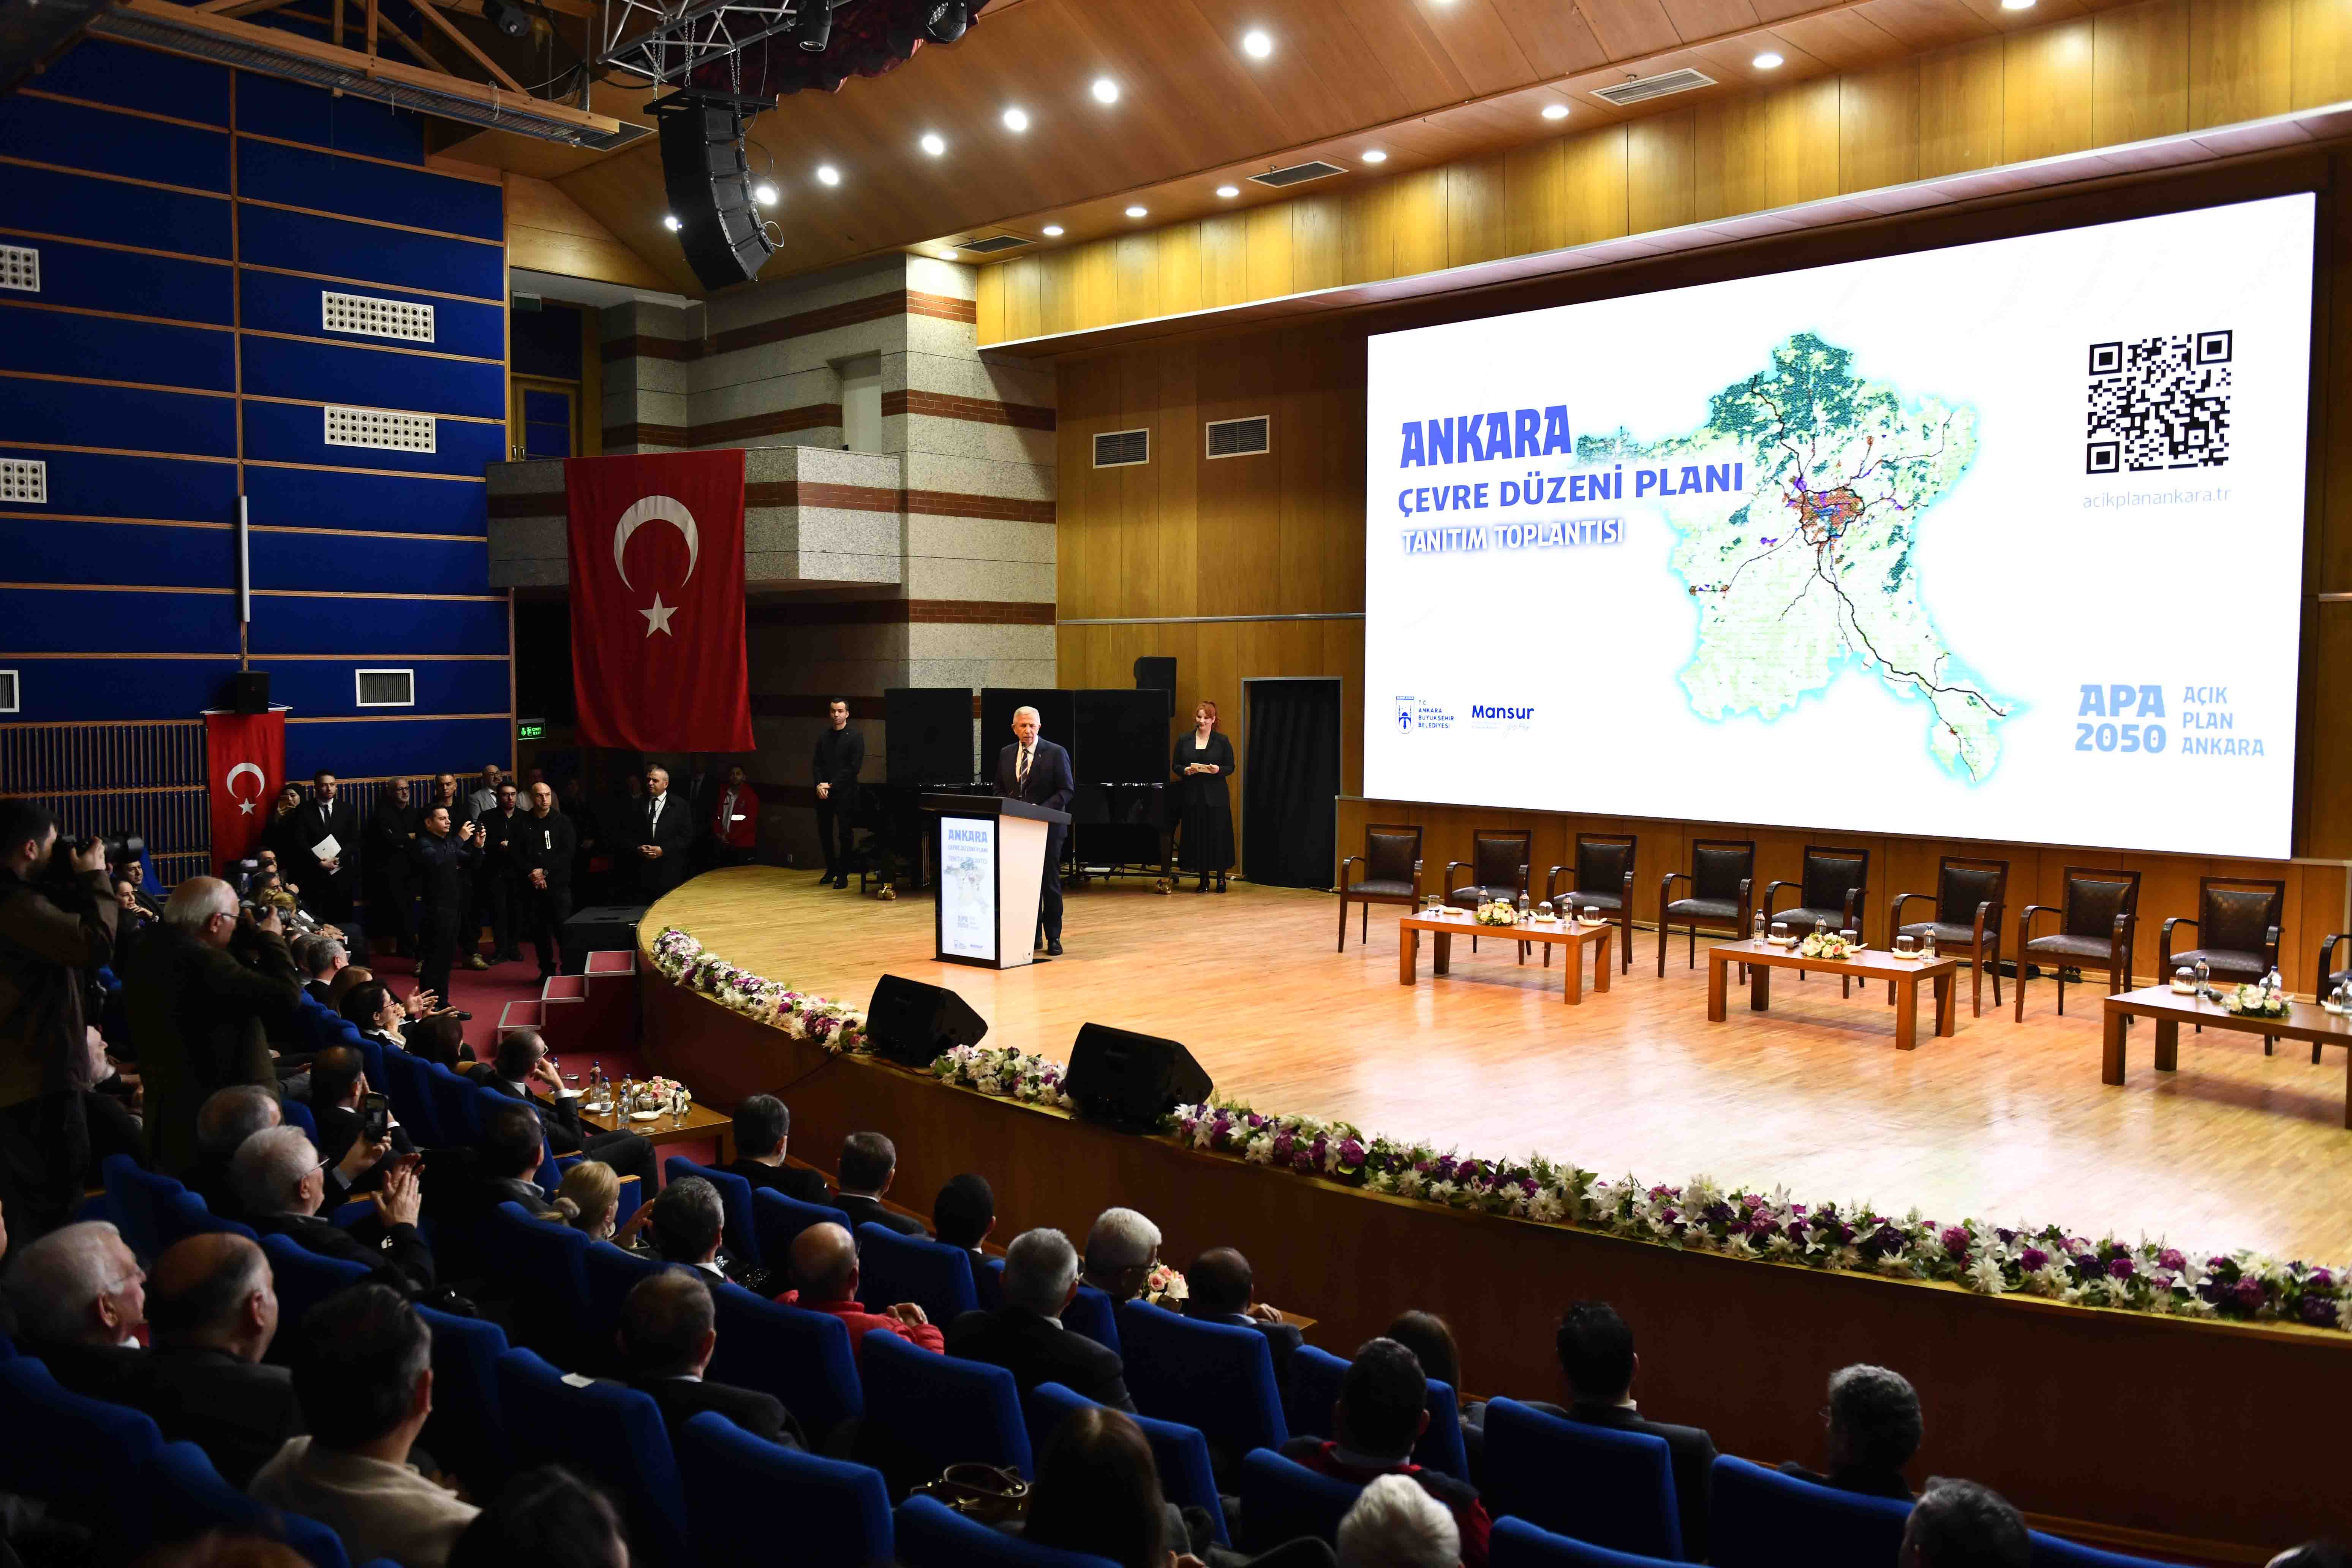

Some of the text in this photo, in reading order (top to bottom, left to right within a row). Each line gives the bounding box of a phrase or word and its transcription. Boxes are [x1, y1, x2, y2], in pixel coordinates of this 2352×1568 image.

[1400, 405, 1572, 468] ANKARA
[1399, 463, 1742, 517] ÇEVRE DÜZENİ PLANI
[2083, 487, 2231, 510] acikplanankara.tr
[1402, 519, 1623, 553] TANITIM TOPLANTISI
[2078, 684, 2166, 718] APA
[2183, 686, 2228, 706] AÇIK
[1472, 705, 1535, 719] Mansur
[2183, 711, 2233, 730] PLAN
[2075, 723, 2167, 754] 2050
[2181, 737, 2264, 756] ANKARA
[948, 829, 987, 843] ANKARA
